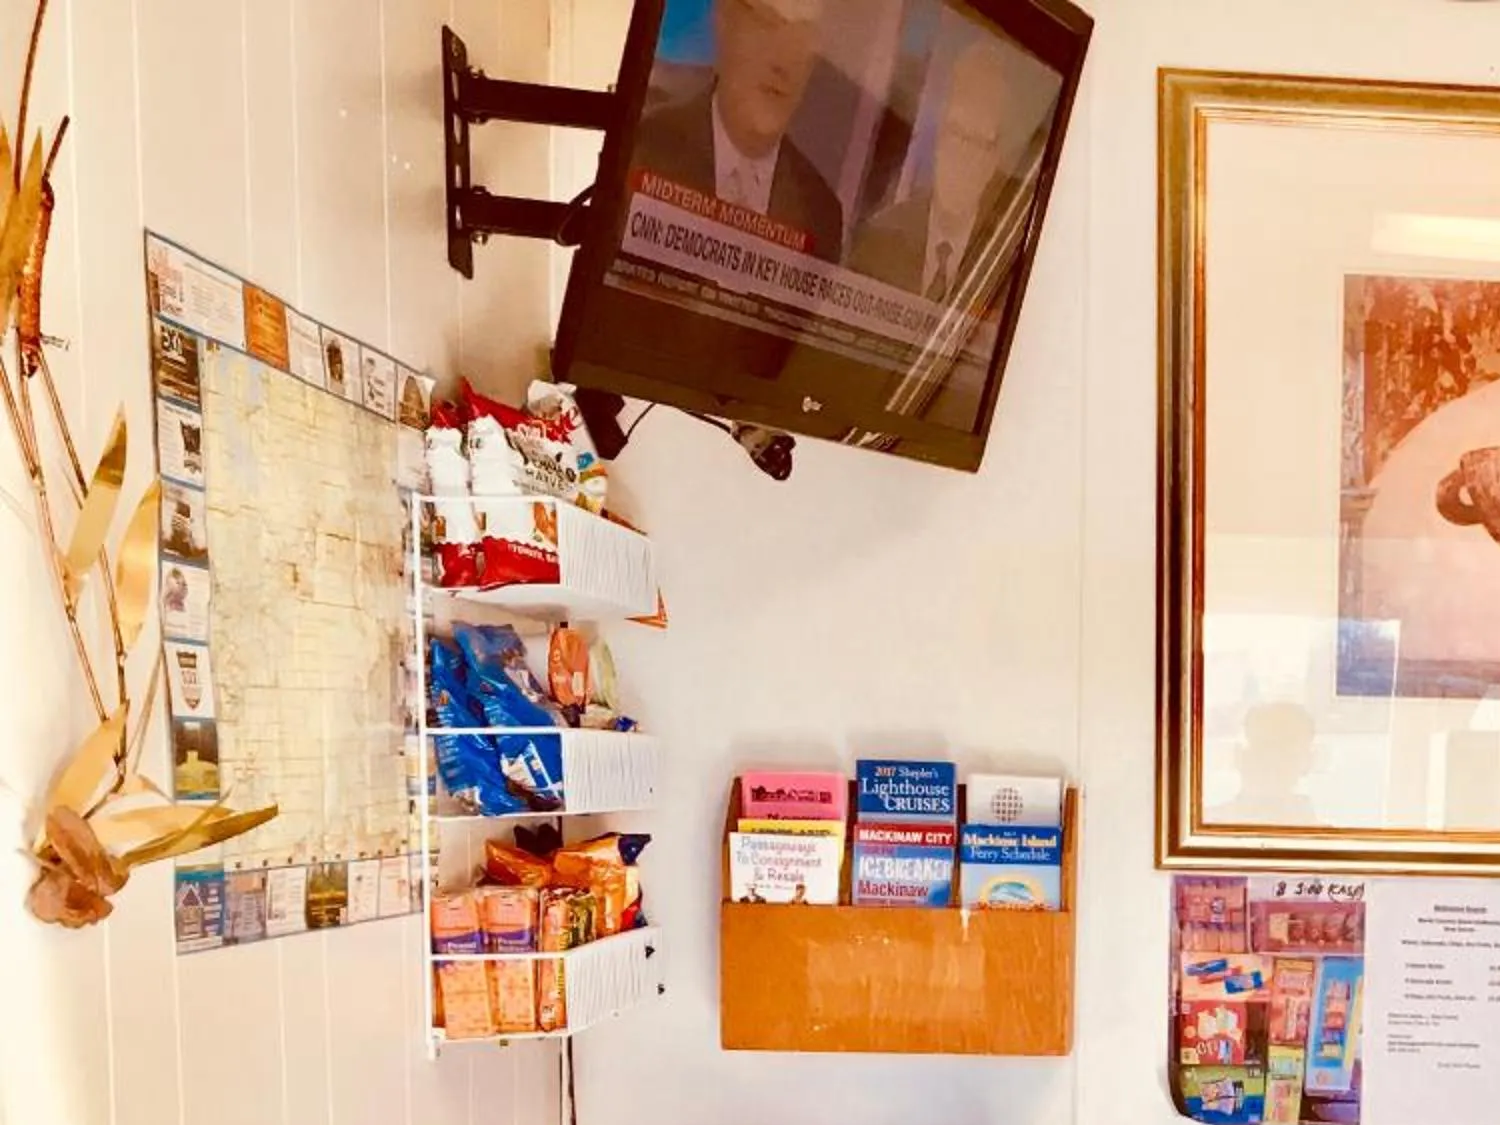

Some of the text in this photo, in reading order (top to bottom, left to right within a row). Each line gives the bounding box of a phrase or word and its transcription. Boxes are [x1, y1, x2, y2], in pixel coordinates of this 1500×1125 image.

[641, 173, 806, 250] MIDTERM MOMENTUM
[631, 211, 664, 246] CNN:
[664, 223, 742, 272] DEMOCRATS
[757, 253, 780, 284] KEY
[780, 264, 820, 299] HOUSE
[898, 766, 939, 780] Shepler's
[862, 777, 950, 799] Lighthouse
[884, 796, 950, 813] CRUISES
[859, 829, 953, 844] MACKINAW CITY
[1021, 832, 1057, 848] Island
[970, 847, 1051, 862] Ferry Schedule
[768, 867, 805, 882] Resale
[858, 880, 929, 898] Mackinaw
